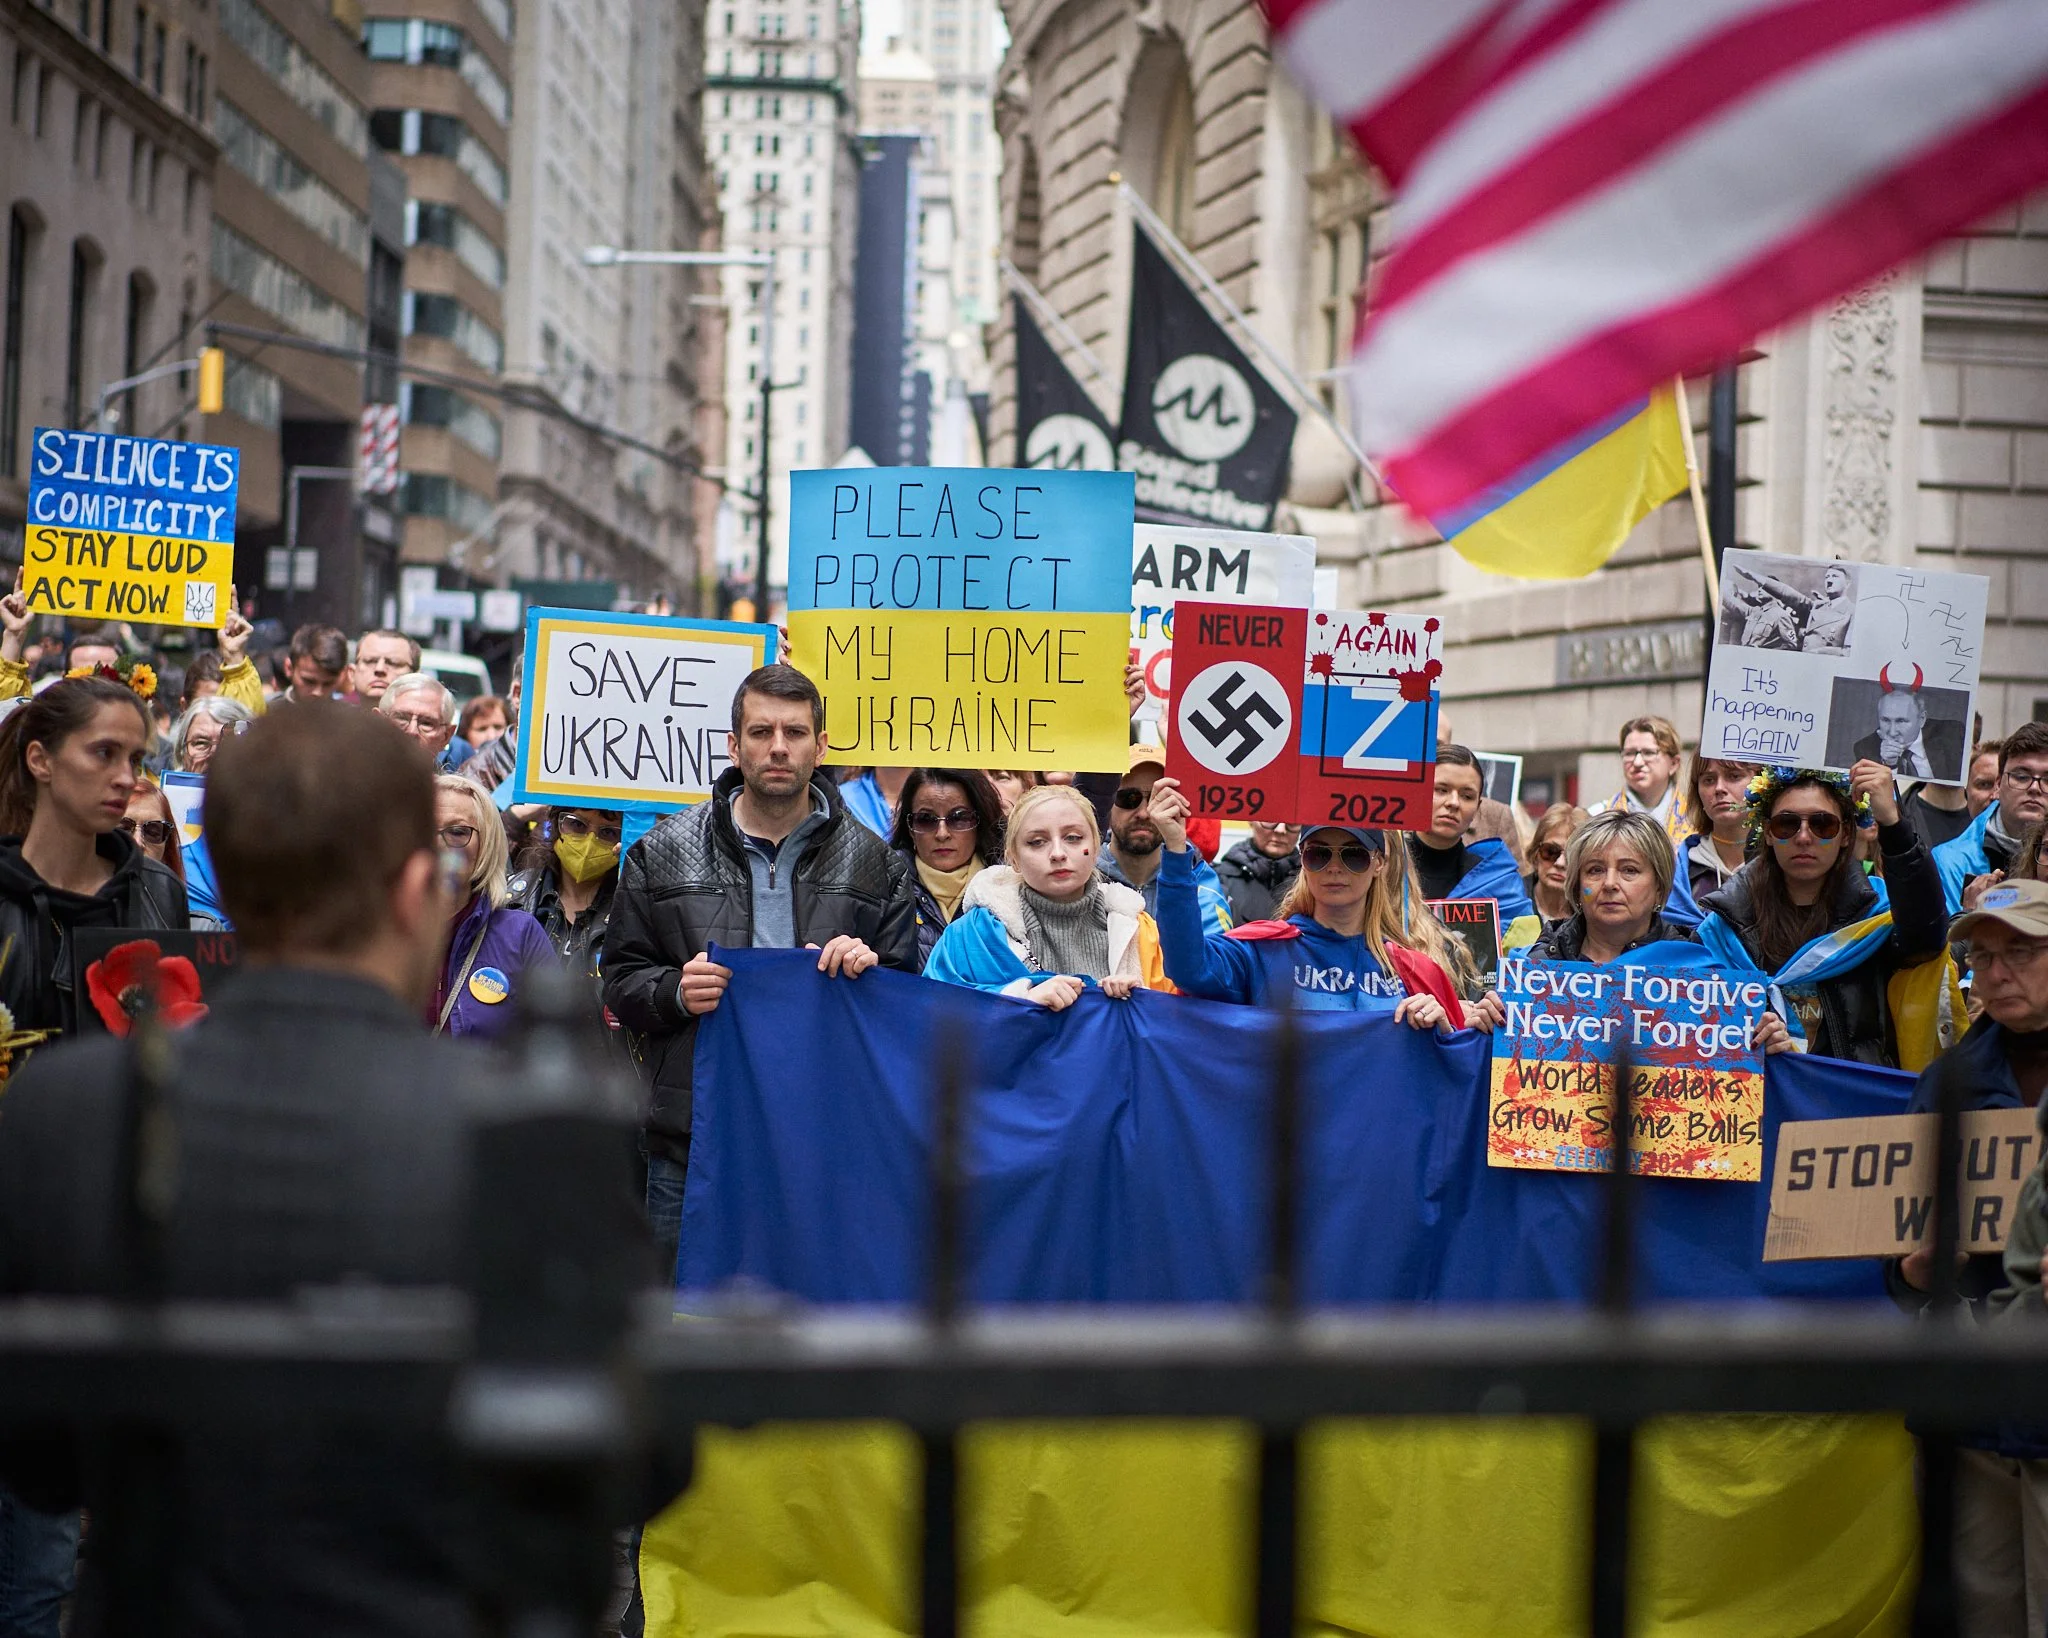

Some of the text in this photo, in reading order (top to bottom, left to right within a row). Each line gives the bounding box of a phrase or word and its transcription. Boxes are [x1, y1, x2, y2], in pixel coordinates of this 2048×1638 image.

[37, 430, 235, 494] SILENCE IS
[831, 483, 1043, 540] PLEASE
[31, 529, 117, 569] STAY
[1132, 543, 1251, 595] ARM
[26, 576, 103, 611] ACT
[814, 553, 1071, 610] PROTECT
[1198, 612, 1285, 648] NEVER
[1334, 622, 1418, 660] AGAIN
[568, 641, 716, 708] SAVE
[825, 625, 893, 681] MY
[945, 626, 1086, 684] HOME
[1741, 666, 1779, 695] It's
[1711, 689, 1815, 733] happening
[1722, 723, 1801, 752] AGAIN
[1197, 784, 1265, 816] 1939
[1328, 793, 1406, 825] 2022
[1429, 903, 1488, 923] TIME
[1496, 957, 1765, 1014] Never Forgive
[1503, 1001, 1755, 1058] Never Forget
[1516, 1059, 1743, 1101] World eaders
[1492, 1099, 1574, 1134] Grow
[1687, 1110, 1763, 1146] Balls!
[1787, 1142, 1914, 1192] STOP
[1894, 1196, 2004, 1242] WR
